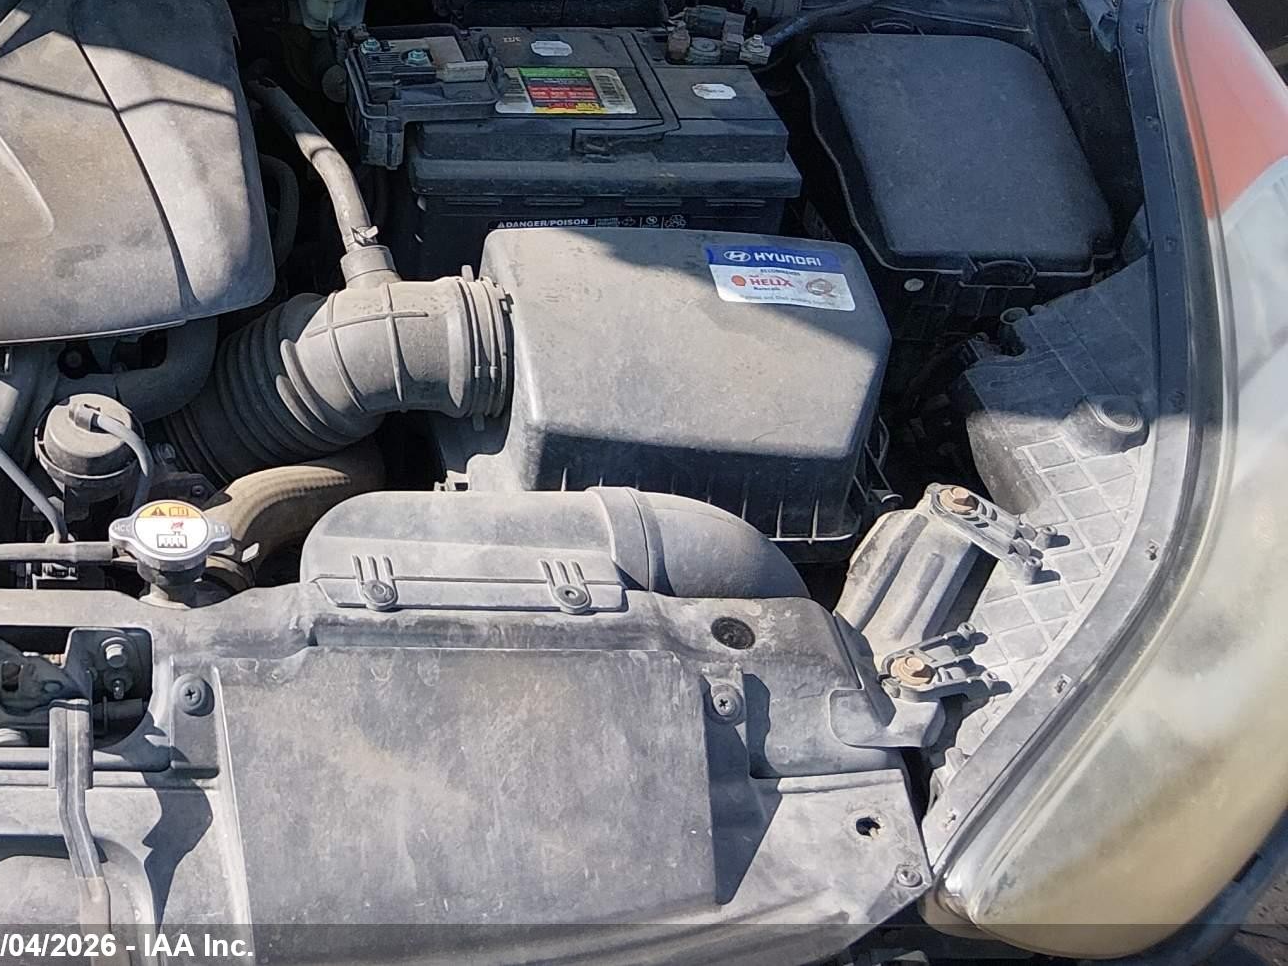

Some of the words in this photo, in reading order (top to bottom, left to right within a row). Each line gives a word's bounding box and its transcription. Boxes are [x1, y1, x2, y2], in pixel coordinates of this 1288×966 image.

[505, 218, 589, 229] DANGER/POISON
[753, 252, 822, 267] HYUNDAI
[749, 277, 795, 288] HELIX
